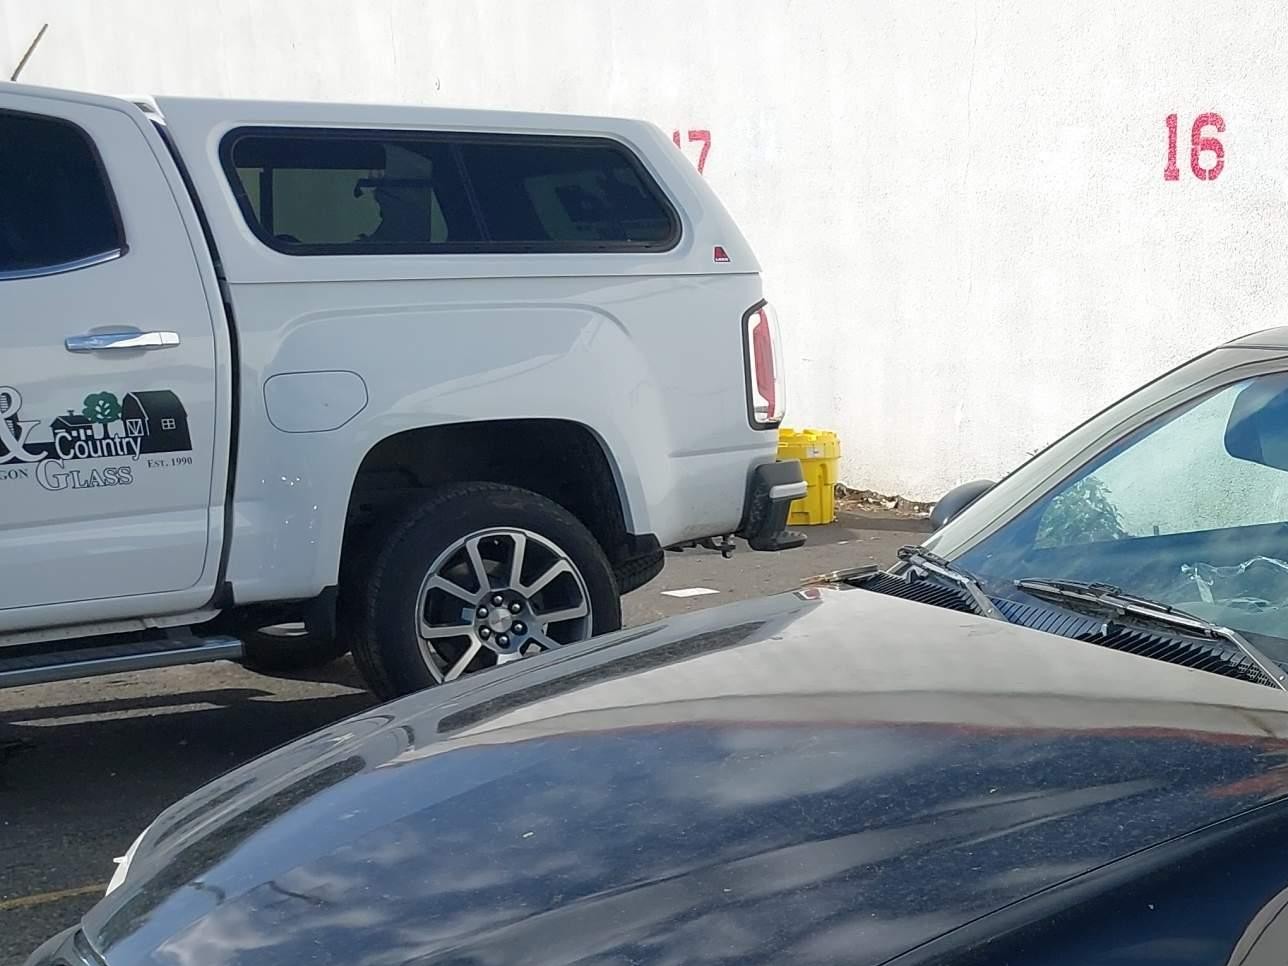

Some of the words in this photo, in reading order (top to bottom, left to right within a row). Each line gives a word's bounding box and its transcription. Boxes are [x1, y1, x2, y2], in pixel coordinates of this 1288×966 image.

[1164, 112, 1226, 181] 16
[55, 431, 142, 461] Country
[171, 457, 193, 466] 1990
[36, 458, 134, 491] GLASS
